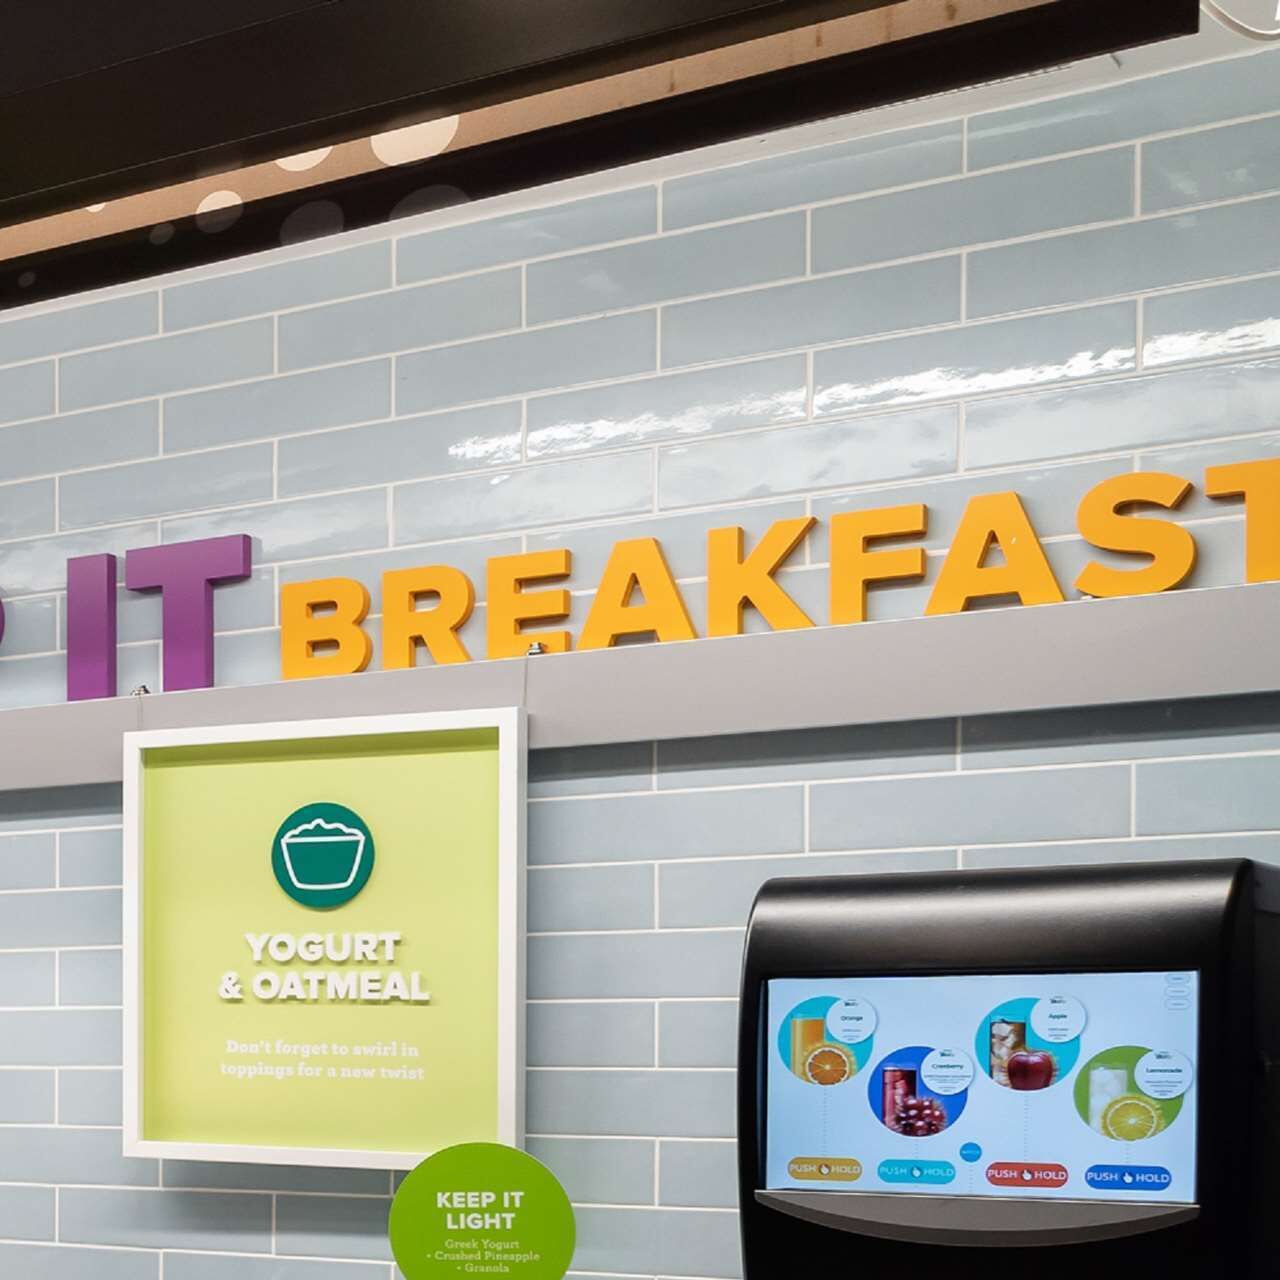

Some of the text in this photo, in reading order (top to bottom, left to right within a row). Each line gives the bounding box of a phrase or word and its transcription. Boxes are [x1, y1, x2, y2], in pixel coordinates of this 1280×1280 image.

[66, 533, 252, 702] IT
[244, 932, 403, 963] YOGURT
[218, 971, 431, 1003] & OATMEAL
[226, 1040, 419, 1058] Don't forget to swirl in
[221, 1062, 425, 1080] toppings for a new twist
[789, 1162, 861, 1175] PUSH HOLD
[879, 1165, 954, 1178] PUSH HOLD
[987, 1168, 1067, 1181] PUSH HOLD
[1086, 1171, 1169, 1184] PUSH HOLD
[436, 1192, 524, 1209] KEEP IT
[446, 1213, 516, 1230] LIGHT
[444, 1239, 520, 1251] Greek Yogurt
[434, 1250, 540, 1263] Crushed Pineapple
[464, 1263, 510, 1273] Granola
